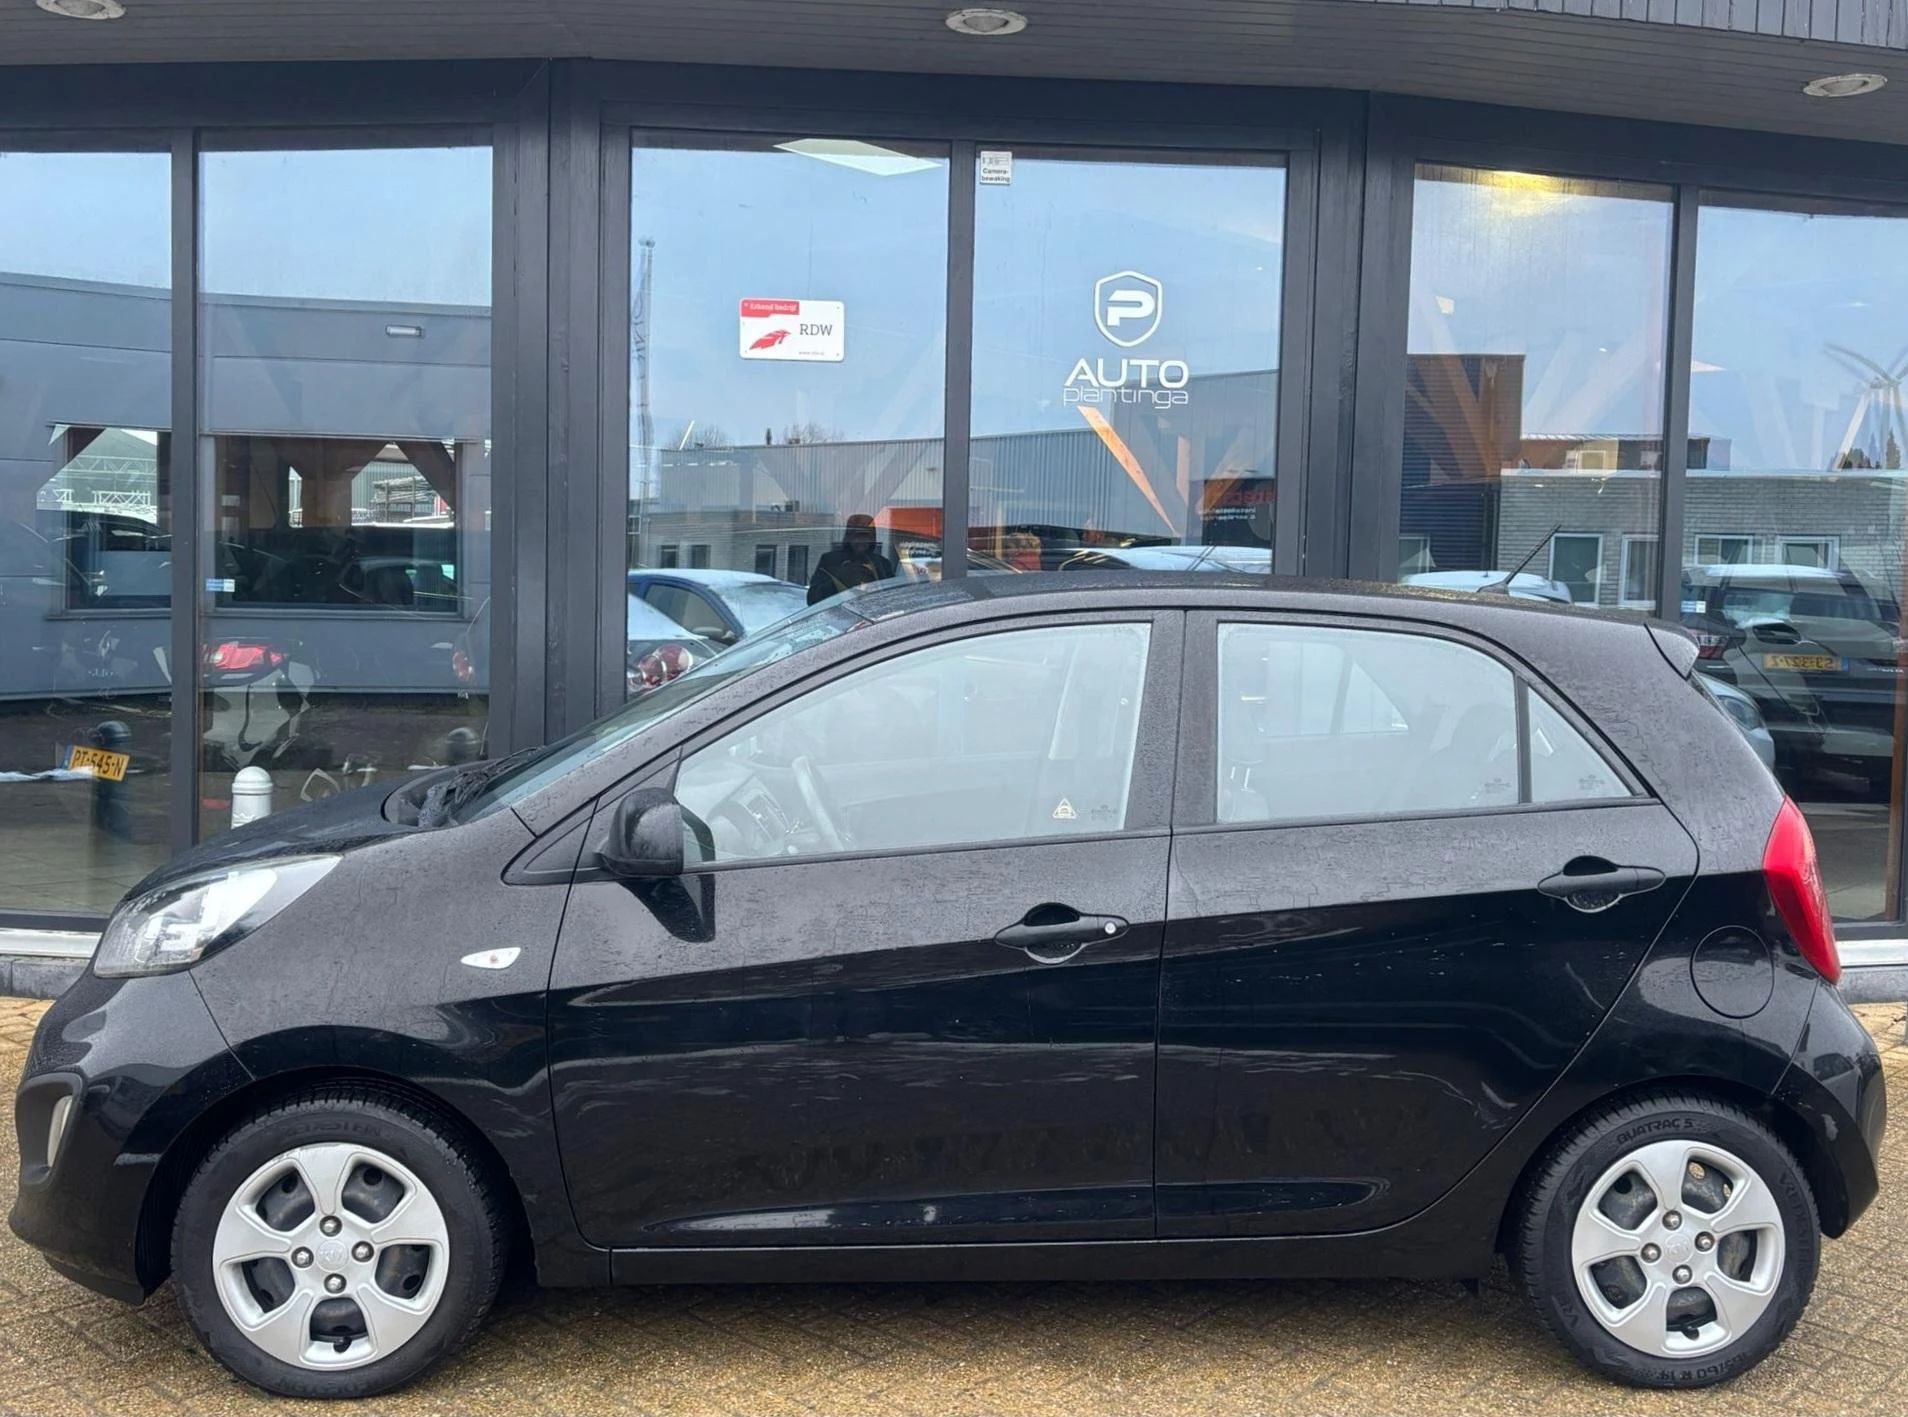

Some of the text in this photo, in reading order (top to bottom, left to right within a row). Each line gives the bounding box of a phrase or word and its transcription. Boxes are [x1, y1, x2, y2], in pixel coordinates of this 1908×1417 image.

[749, 303, 774, 311] Erkend
[1107, 289, 1155, 327] P
[799, 323, 833, 336] RDW
[1064, 358, 1189, 389] AUTO
[1063, 385, 1189, 409] plantinga
[1617, 1118, 1696, 1143] QUATRAC 5
